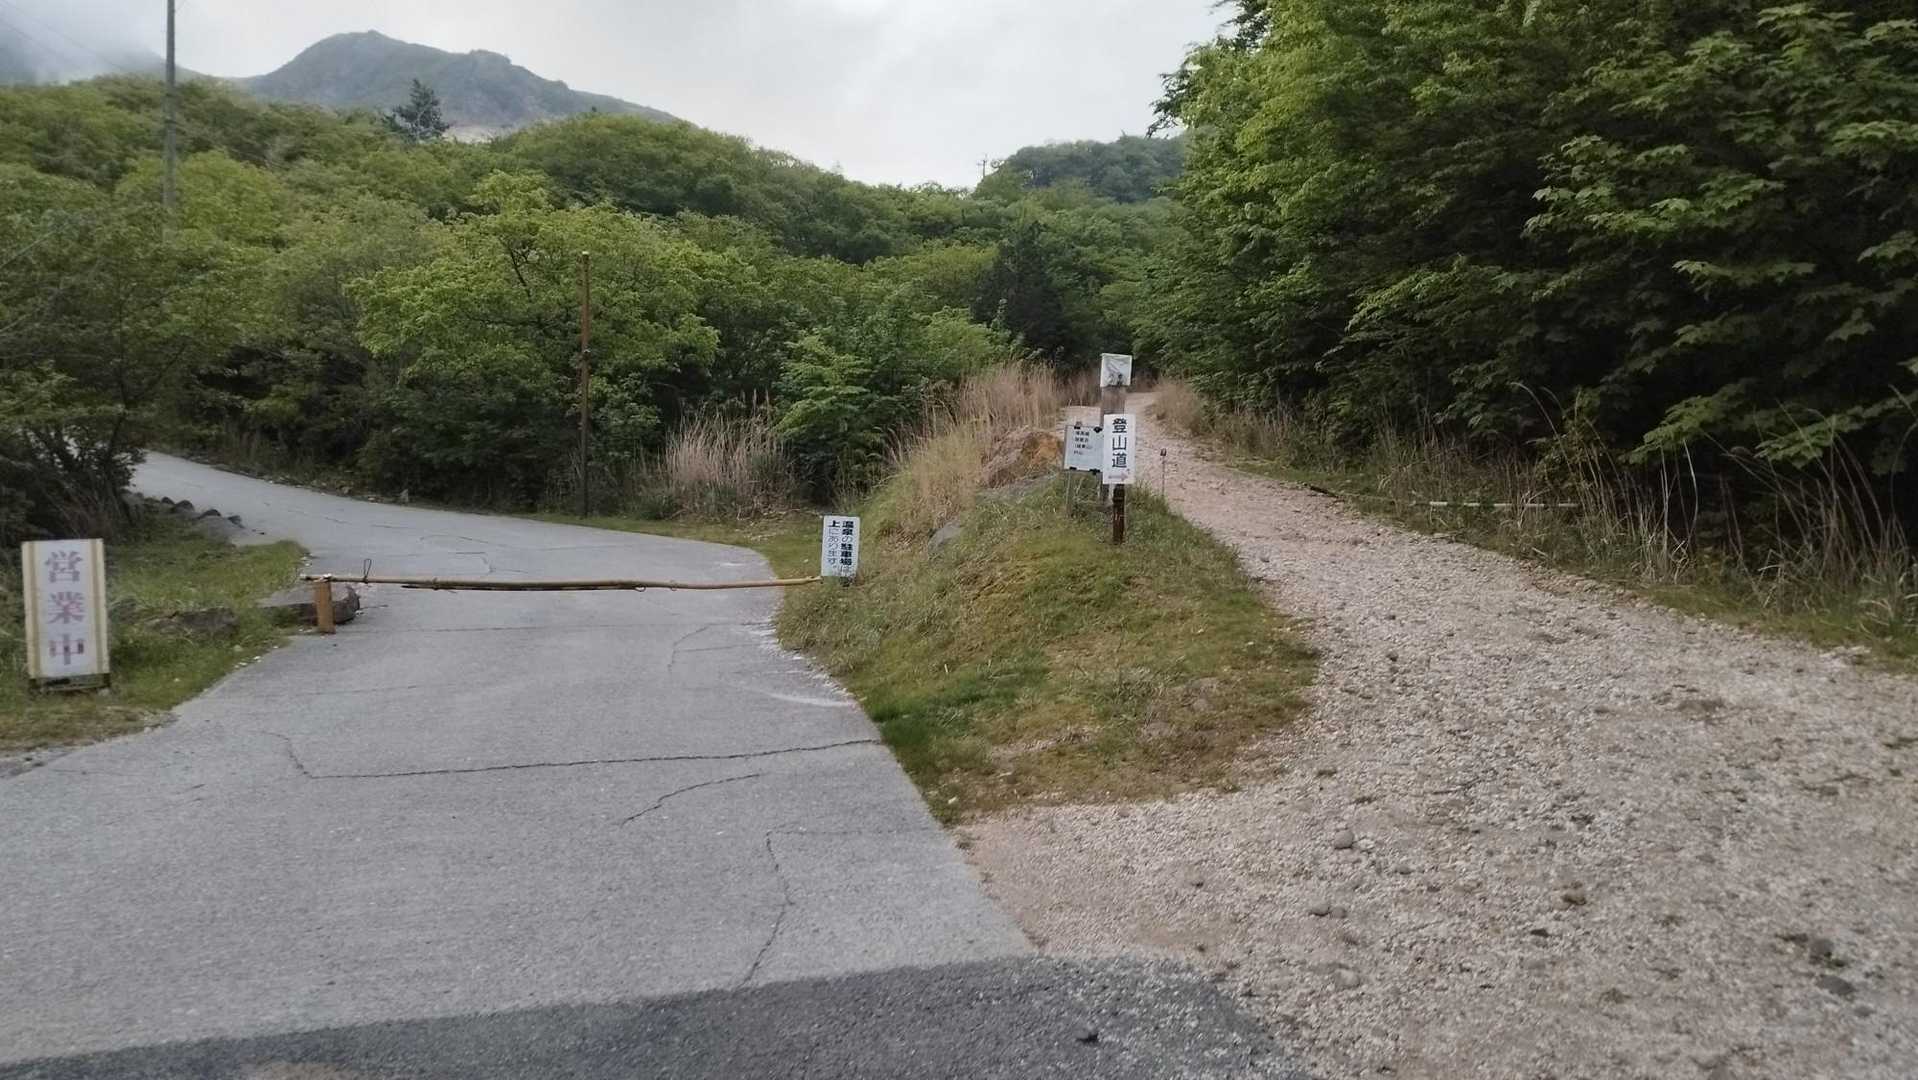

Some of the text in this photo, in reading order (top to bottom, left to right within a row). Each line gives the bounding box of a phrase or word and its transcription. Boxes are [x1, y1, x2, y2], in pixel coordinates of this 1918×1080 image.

[1112, 418, 1127, 468] 登山道
[45, 551, 84, 665] 営業中
